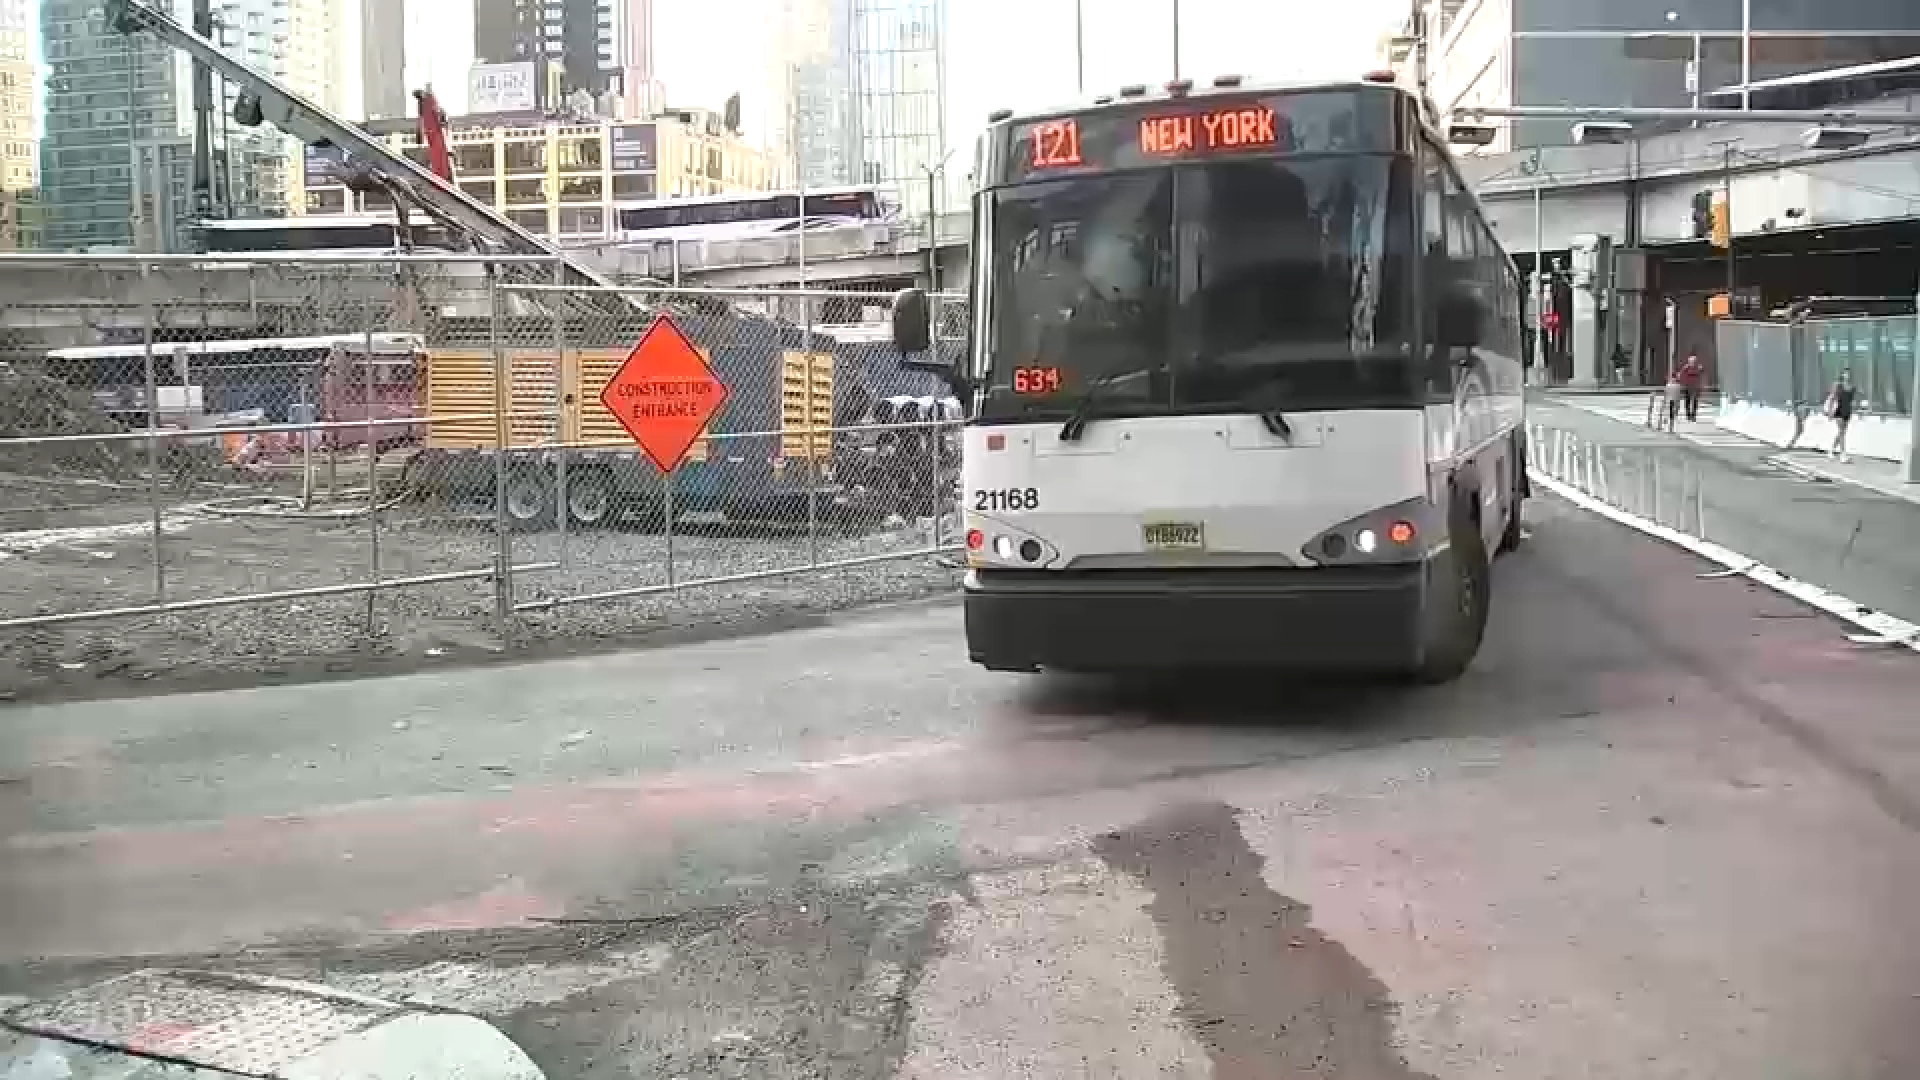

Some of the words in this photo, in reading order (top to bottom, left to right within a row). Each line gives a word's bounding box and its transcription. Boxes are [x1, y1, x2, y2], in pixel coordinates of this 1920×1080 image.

[1032, 119, 1081, 166] 121
[1140, 116, 1193, 152] NEW
[1202, 108, 1275, 147] YORK
[617, 381, 712, 397] CONSTRUCTION
[1015, 367, 1058, 391] 634
[633, 402, 697, 418] ENTRANCE
[975, 488, 1039, 511] 21168
